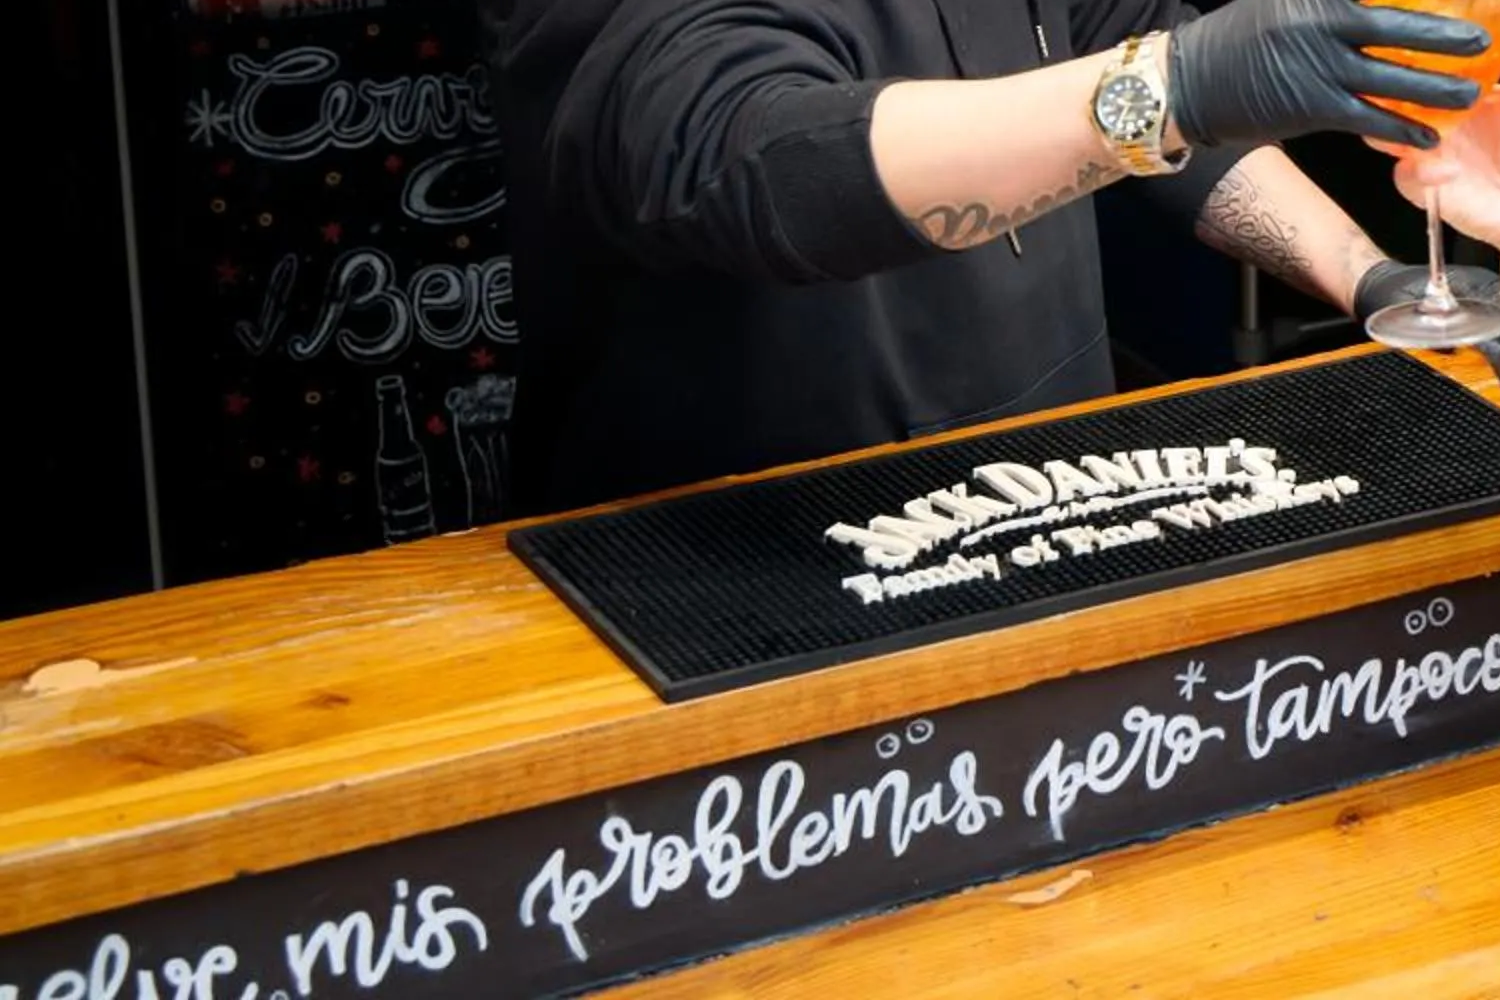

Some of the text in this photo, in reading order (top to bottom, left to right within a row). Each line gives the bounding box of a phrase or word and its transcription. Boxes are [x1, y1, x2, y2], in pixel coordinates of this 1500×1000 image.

[824, 482, 1019, 570] JACK
[842, 551, 1002, 604] Family
[1010, 534, 1059, 566] of
[1050, 519, 1166, 557] Fine
[1152, 474, 1361, 530] Whiskeys
[286, 879, 487, 996] mis
[520, 751, 1003, 961] problemas
[1025, 705, 1224, 840] pero
